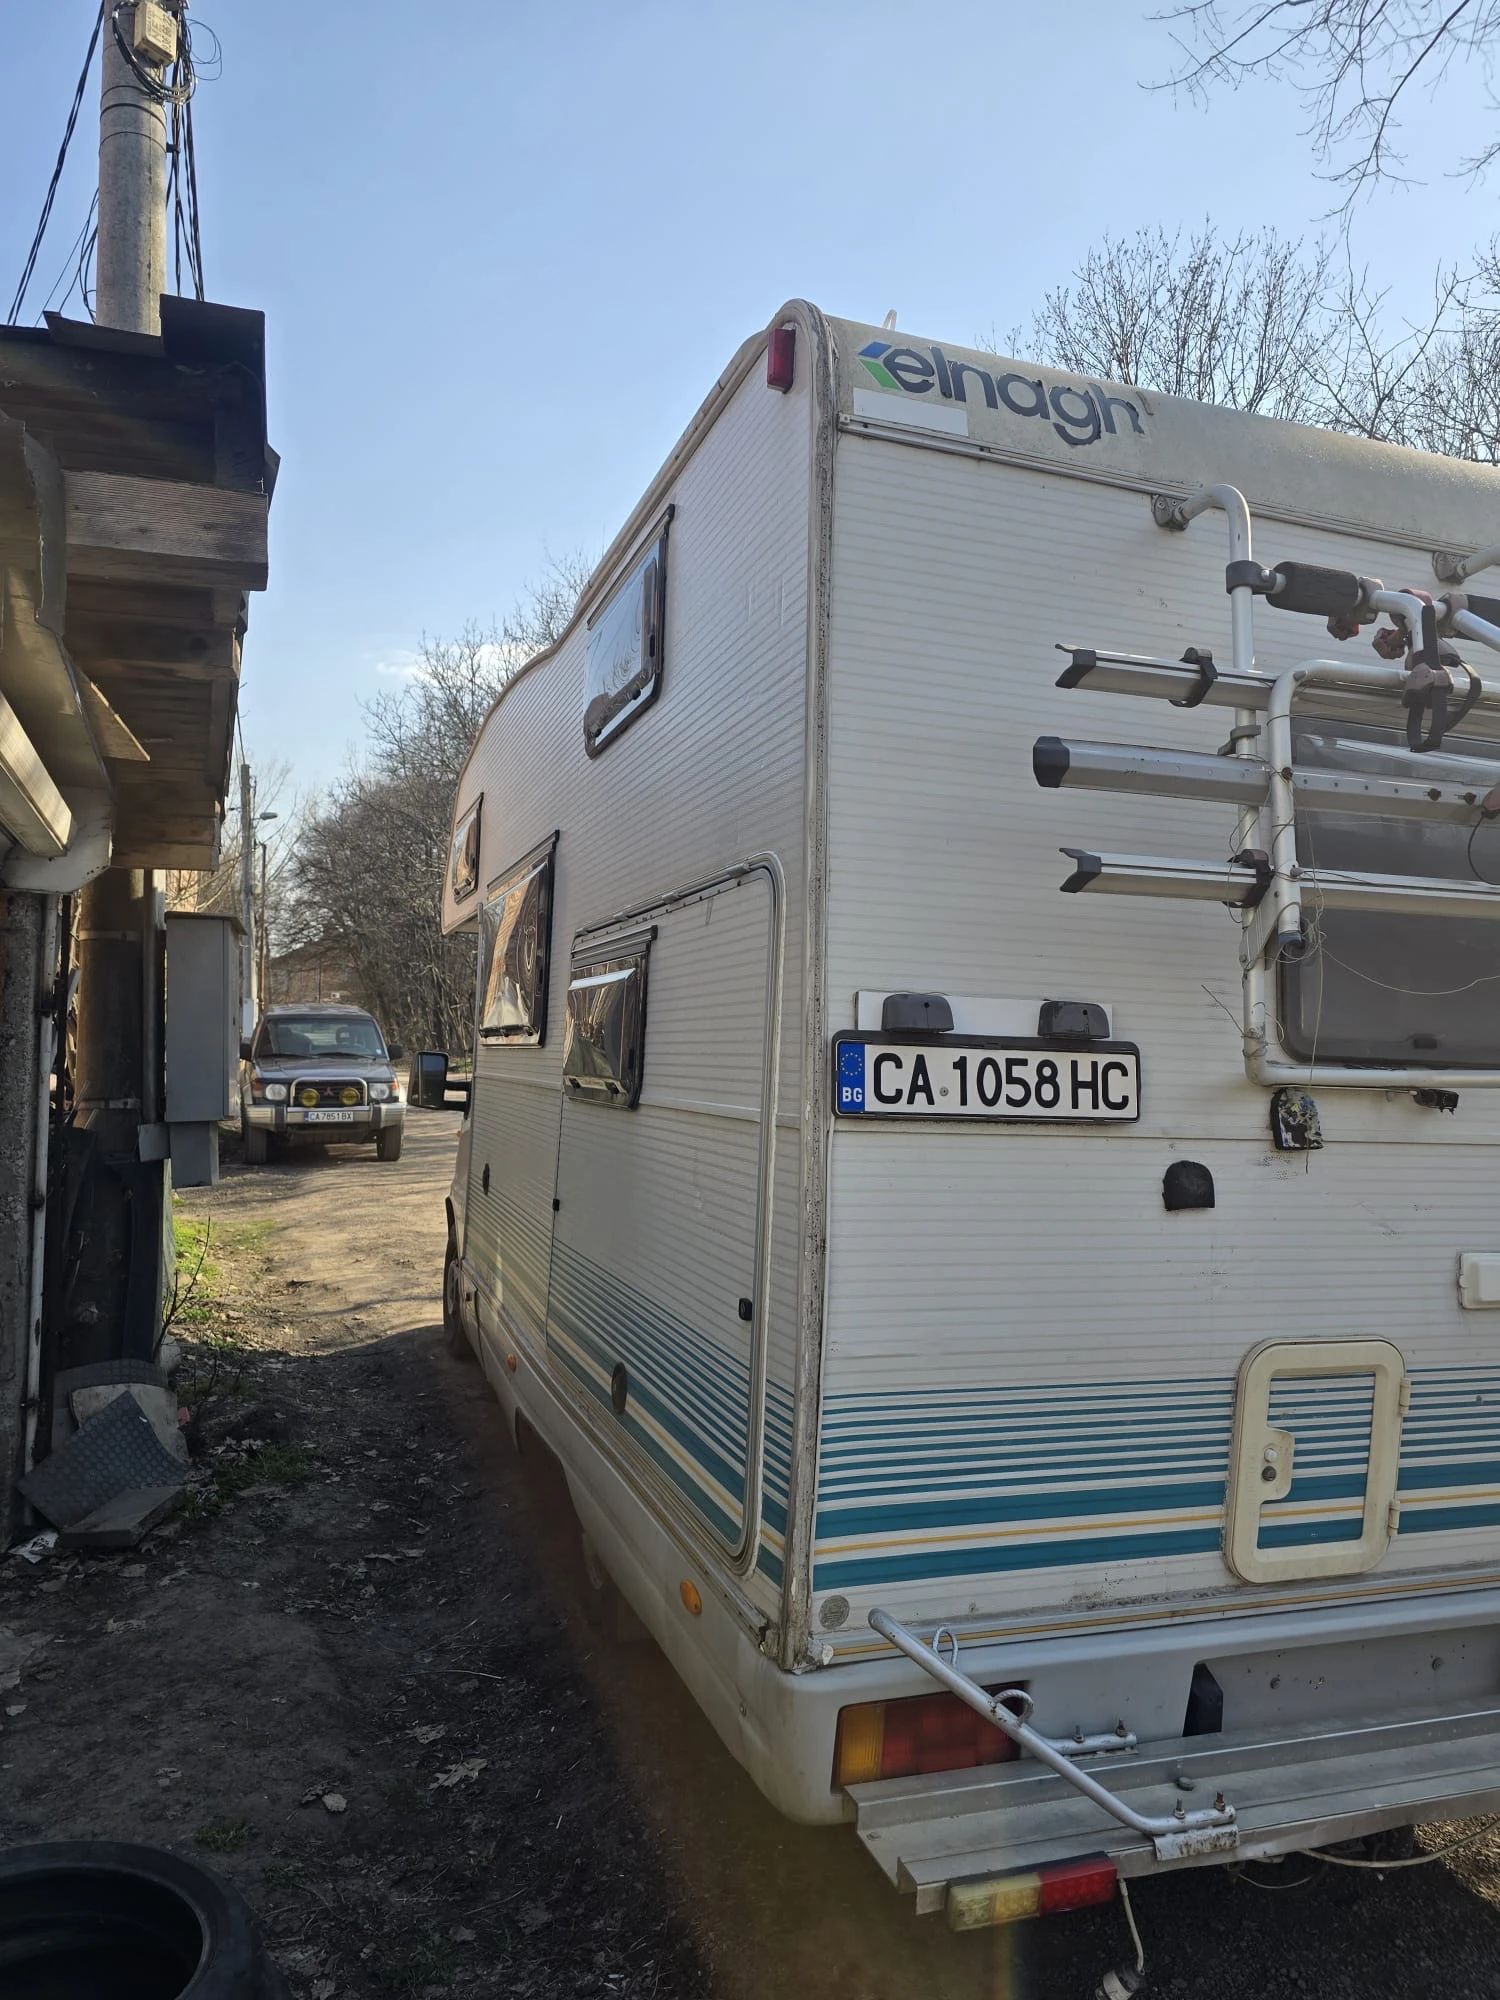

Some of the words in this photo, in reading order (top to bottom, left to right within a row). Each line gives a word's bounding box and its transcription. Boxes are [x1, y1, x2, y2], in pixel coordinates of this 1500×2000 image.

[883, 346, 1144, 446] elnagh
[842, 1087, 863, 1102] BG
[873, 1052, 935, 1106] CA
[952, 1056, 1061, 1108] 1058
[1070, 1060, 1130, 1111] HC
